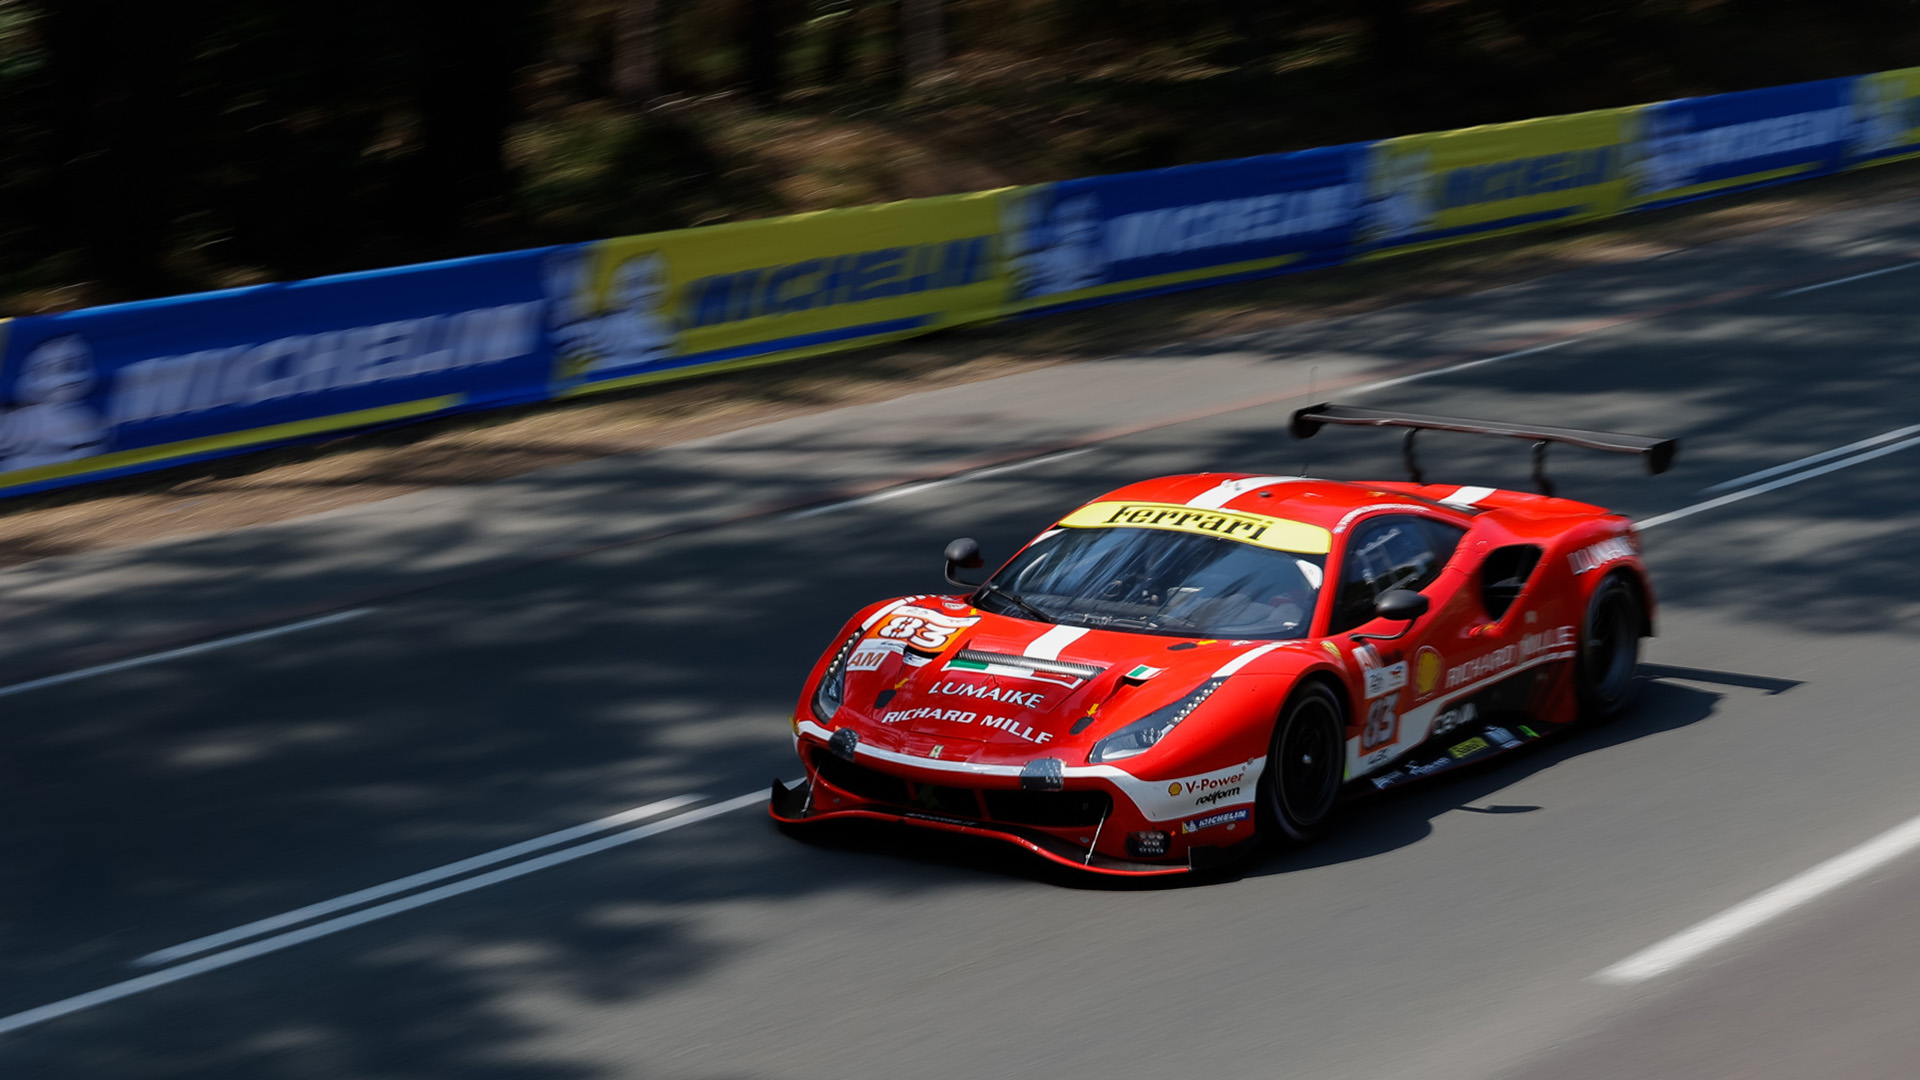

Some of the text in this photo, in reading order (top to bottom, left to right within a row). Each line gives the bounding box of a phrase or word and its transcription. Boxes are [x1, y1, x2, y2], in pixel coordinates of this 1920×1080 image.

[684, 234, 995, 329] MICHELIN
[111, 300, 540, 425] MICHELIN
[1102, 506, 1274, 541] Ferrari
[878, 616, 958, 649] 83
[847, 651, 885, 667] AM
[1445, 625, 1576, 688] RICHARD MILLE
[928, 681, 1045, 709] LUMAIKE
[881, 706, 1053, 744] RICHARD MILLE
[1363, 692, 1400, 749] 83
[1186, 773, 1243, 793] V-Power
[1195, 787, 1240, 805] rotiform
[1199, 810, 1247, 827] MICHELIN
